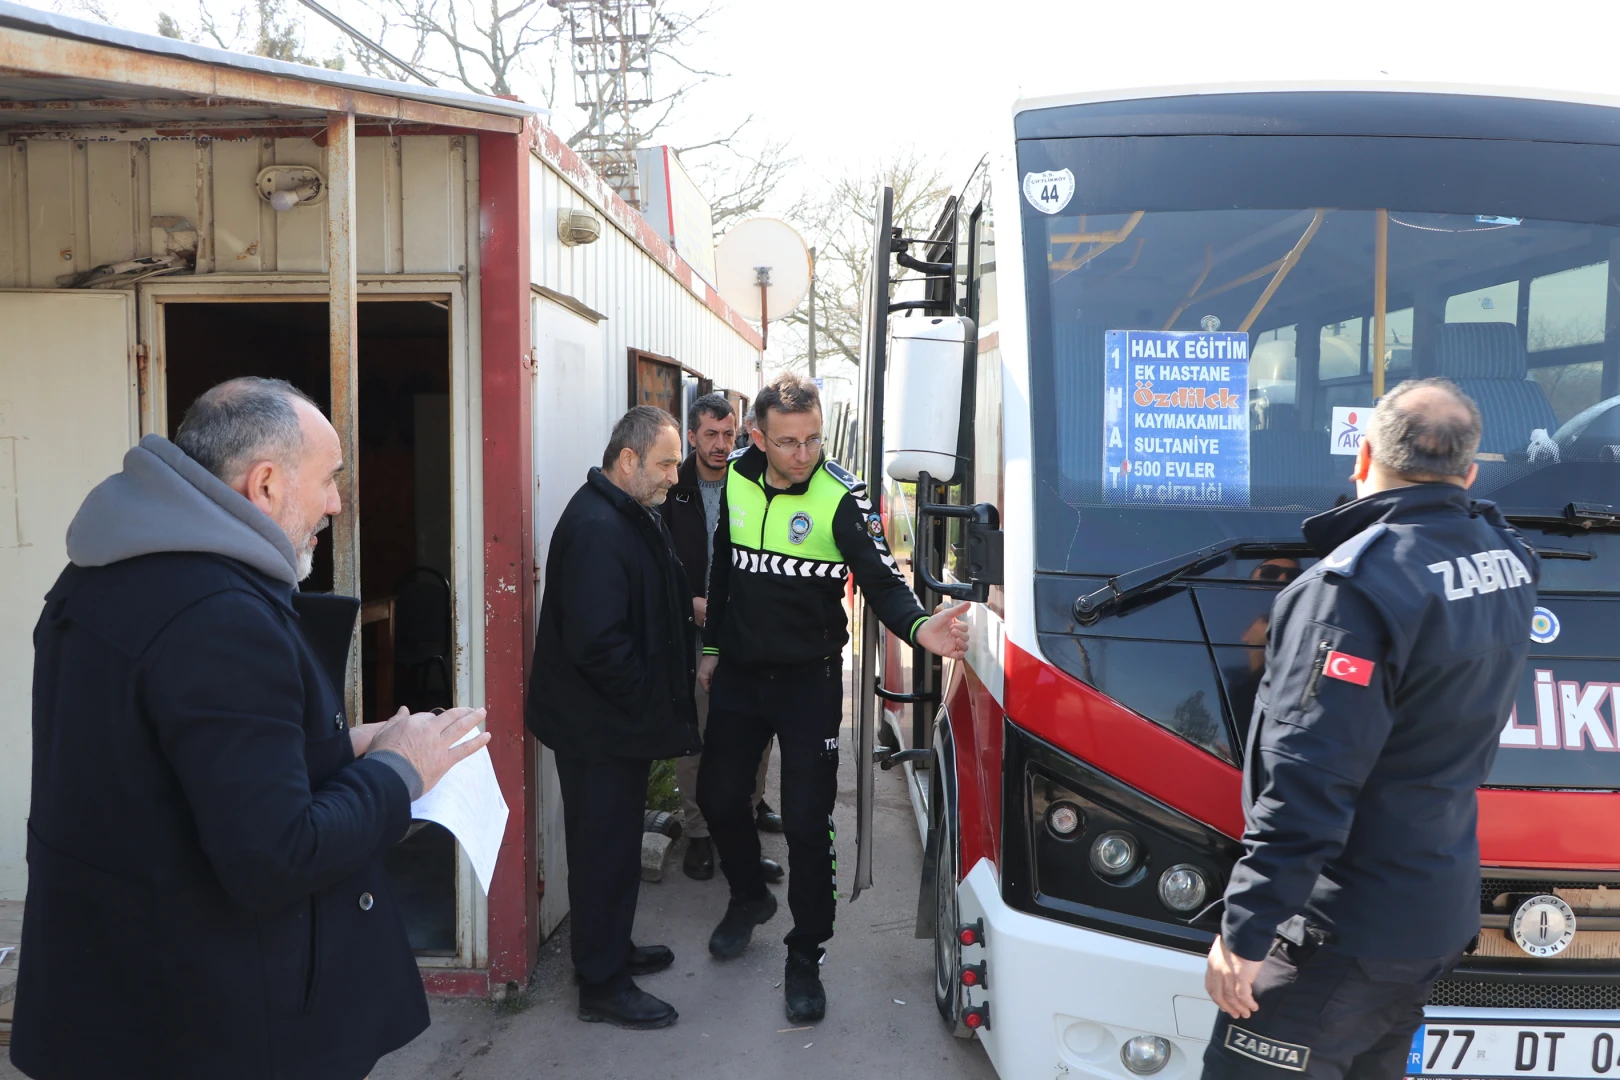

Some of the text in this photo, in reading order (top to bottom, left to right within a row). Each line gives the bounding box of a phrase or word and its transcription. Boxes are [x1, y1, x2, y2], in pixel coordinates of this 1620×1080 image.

[1040, 184, 1059, 203] 44
[1131, 336, 1247, 359] HALK EĞİTİM
[1111, 348, 1120, 369] 1
[1134, 365, 1230, 381] EK HASTANE
[1133, 380, 1240, 410] Özdilek
[1134, 412, 1244, 430] KAYMAKAMLIK
[1134, 435, 1219, 454] SULTANİYE
[1134, 461, 1215, 478] 500 EVLER
[1134, 484, 1153, 499] AT
[1426, 549, 1532, 601] ZABITA
[1233, 1032, 1299, 1064] ZABITA
[1425, 1029, 1475, 1069] 77
[1514, 1031, 1566, 1072] DT
[1591, 1032, 1620, 1074] 0
